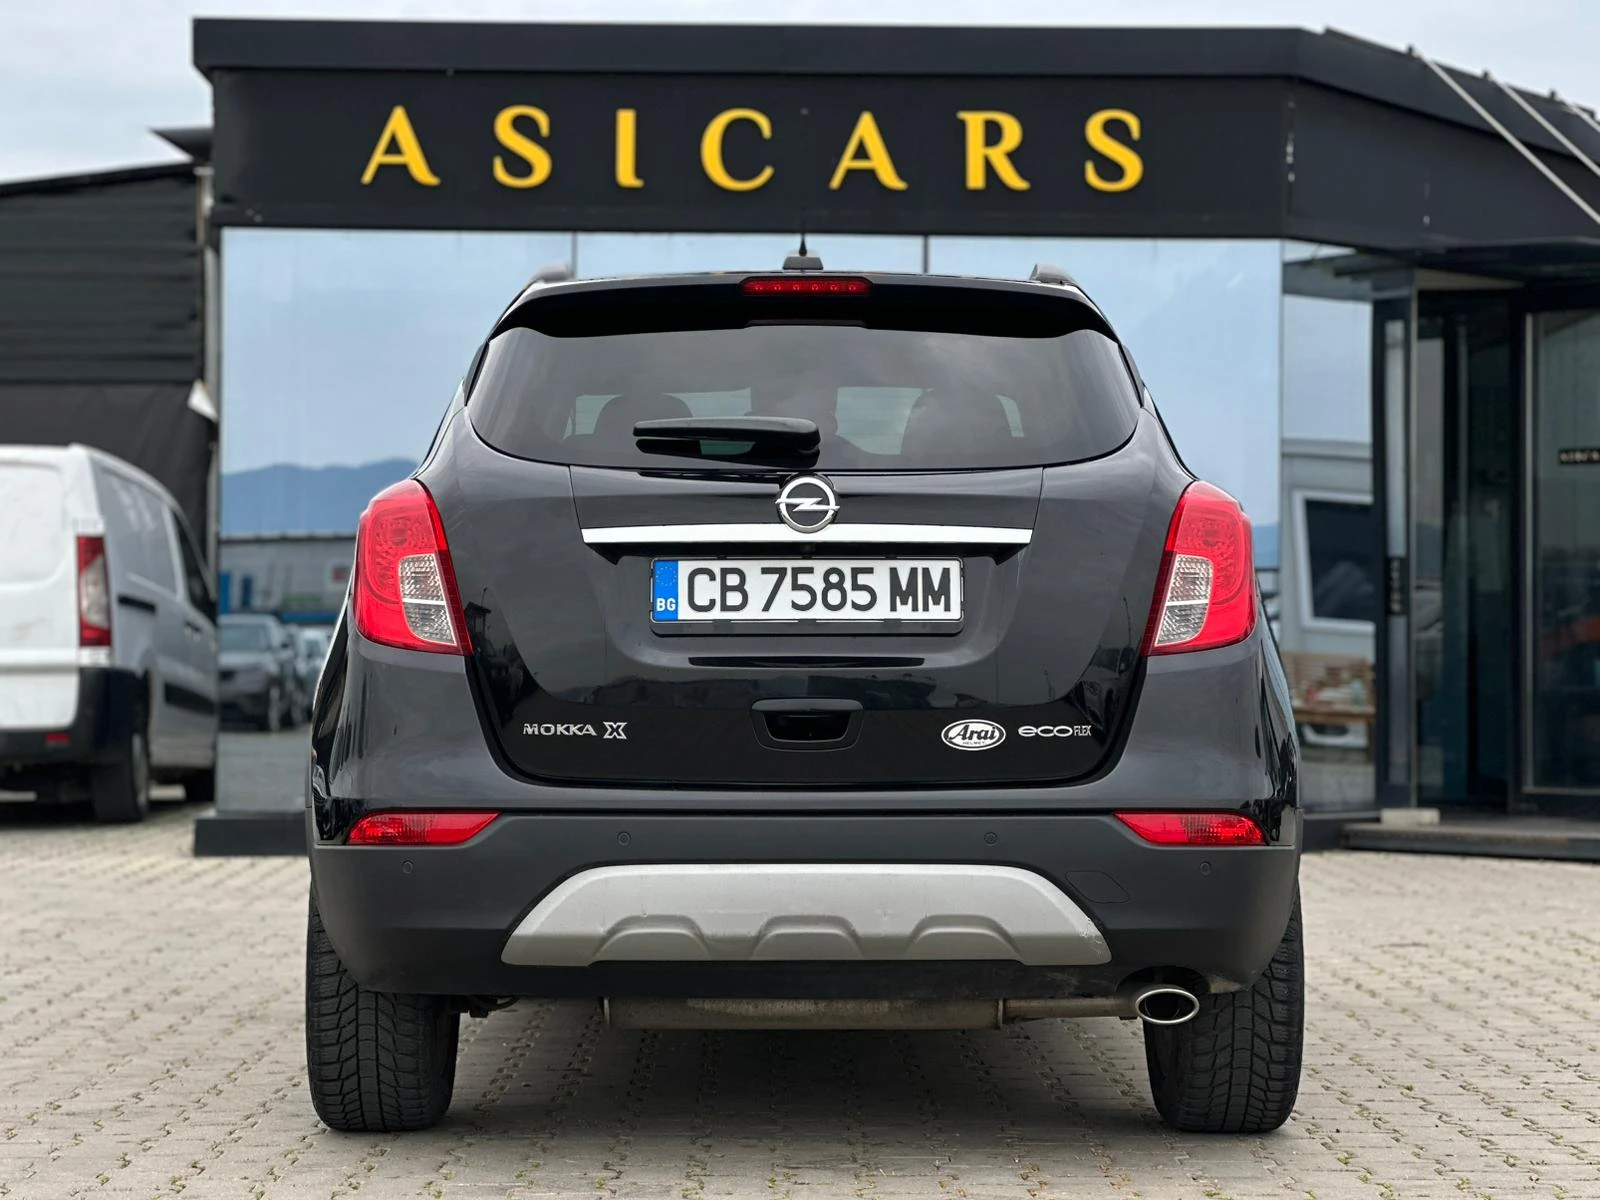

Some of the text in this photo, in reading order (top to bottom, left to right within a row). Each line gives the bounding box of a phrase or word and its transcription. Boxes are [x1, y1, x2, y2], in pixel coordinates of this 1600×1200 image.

[362, 105, 1145, 192] ASICARS
[687, 566, 951, 612] CB 7585 MM
[656, 598, 676, 611] BG
[523, 721, 628, 740] MOKKA X
[947, 724, 997, 741] Arai
